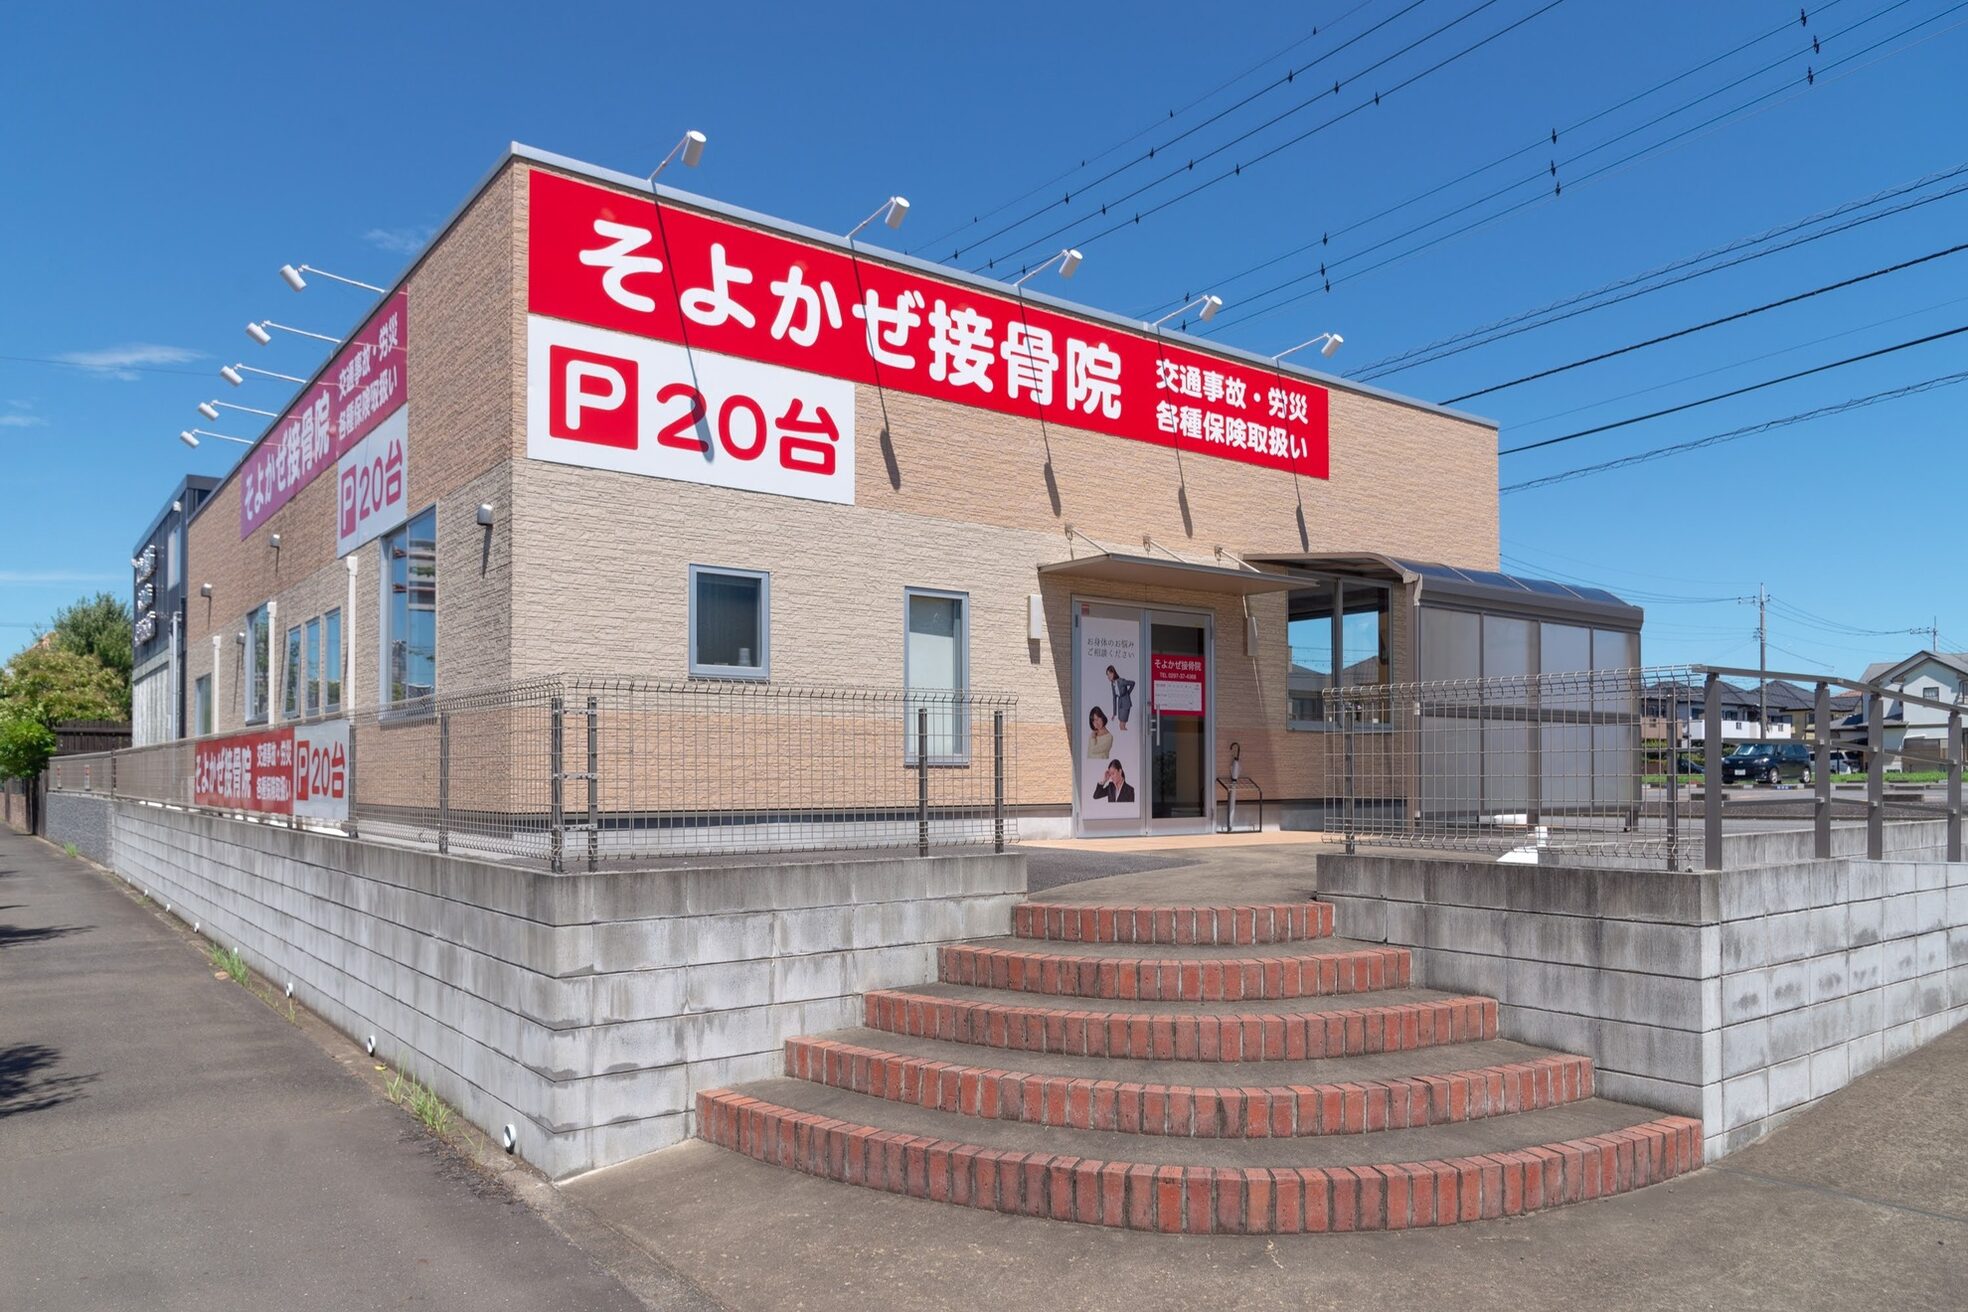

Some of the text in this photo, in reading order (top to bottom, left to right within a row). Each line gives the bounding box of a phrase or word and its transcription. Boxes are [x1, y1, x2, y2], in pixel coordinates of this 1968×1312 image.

[579, 219, 1122, 419] そよかぜ接骨院
[564, 360, 840, 476] P 20台
[1156, 358, 1309, 425] 交通事故・労災
[244, 389, 330, 522] そよかぜ接骨院
[1156, 400, 1308, 459] 各種保険取扱い
[359, 438, 403, 522] 20台
[195, 746, 252, 799] そよかぜ接骨院
[311, 740, 346, 799] 20台
